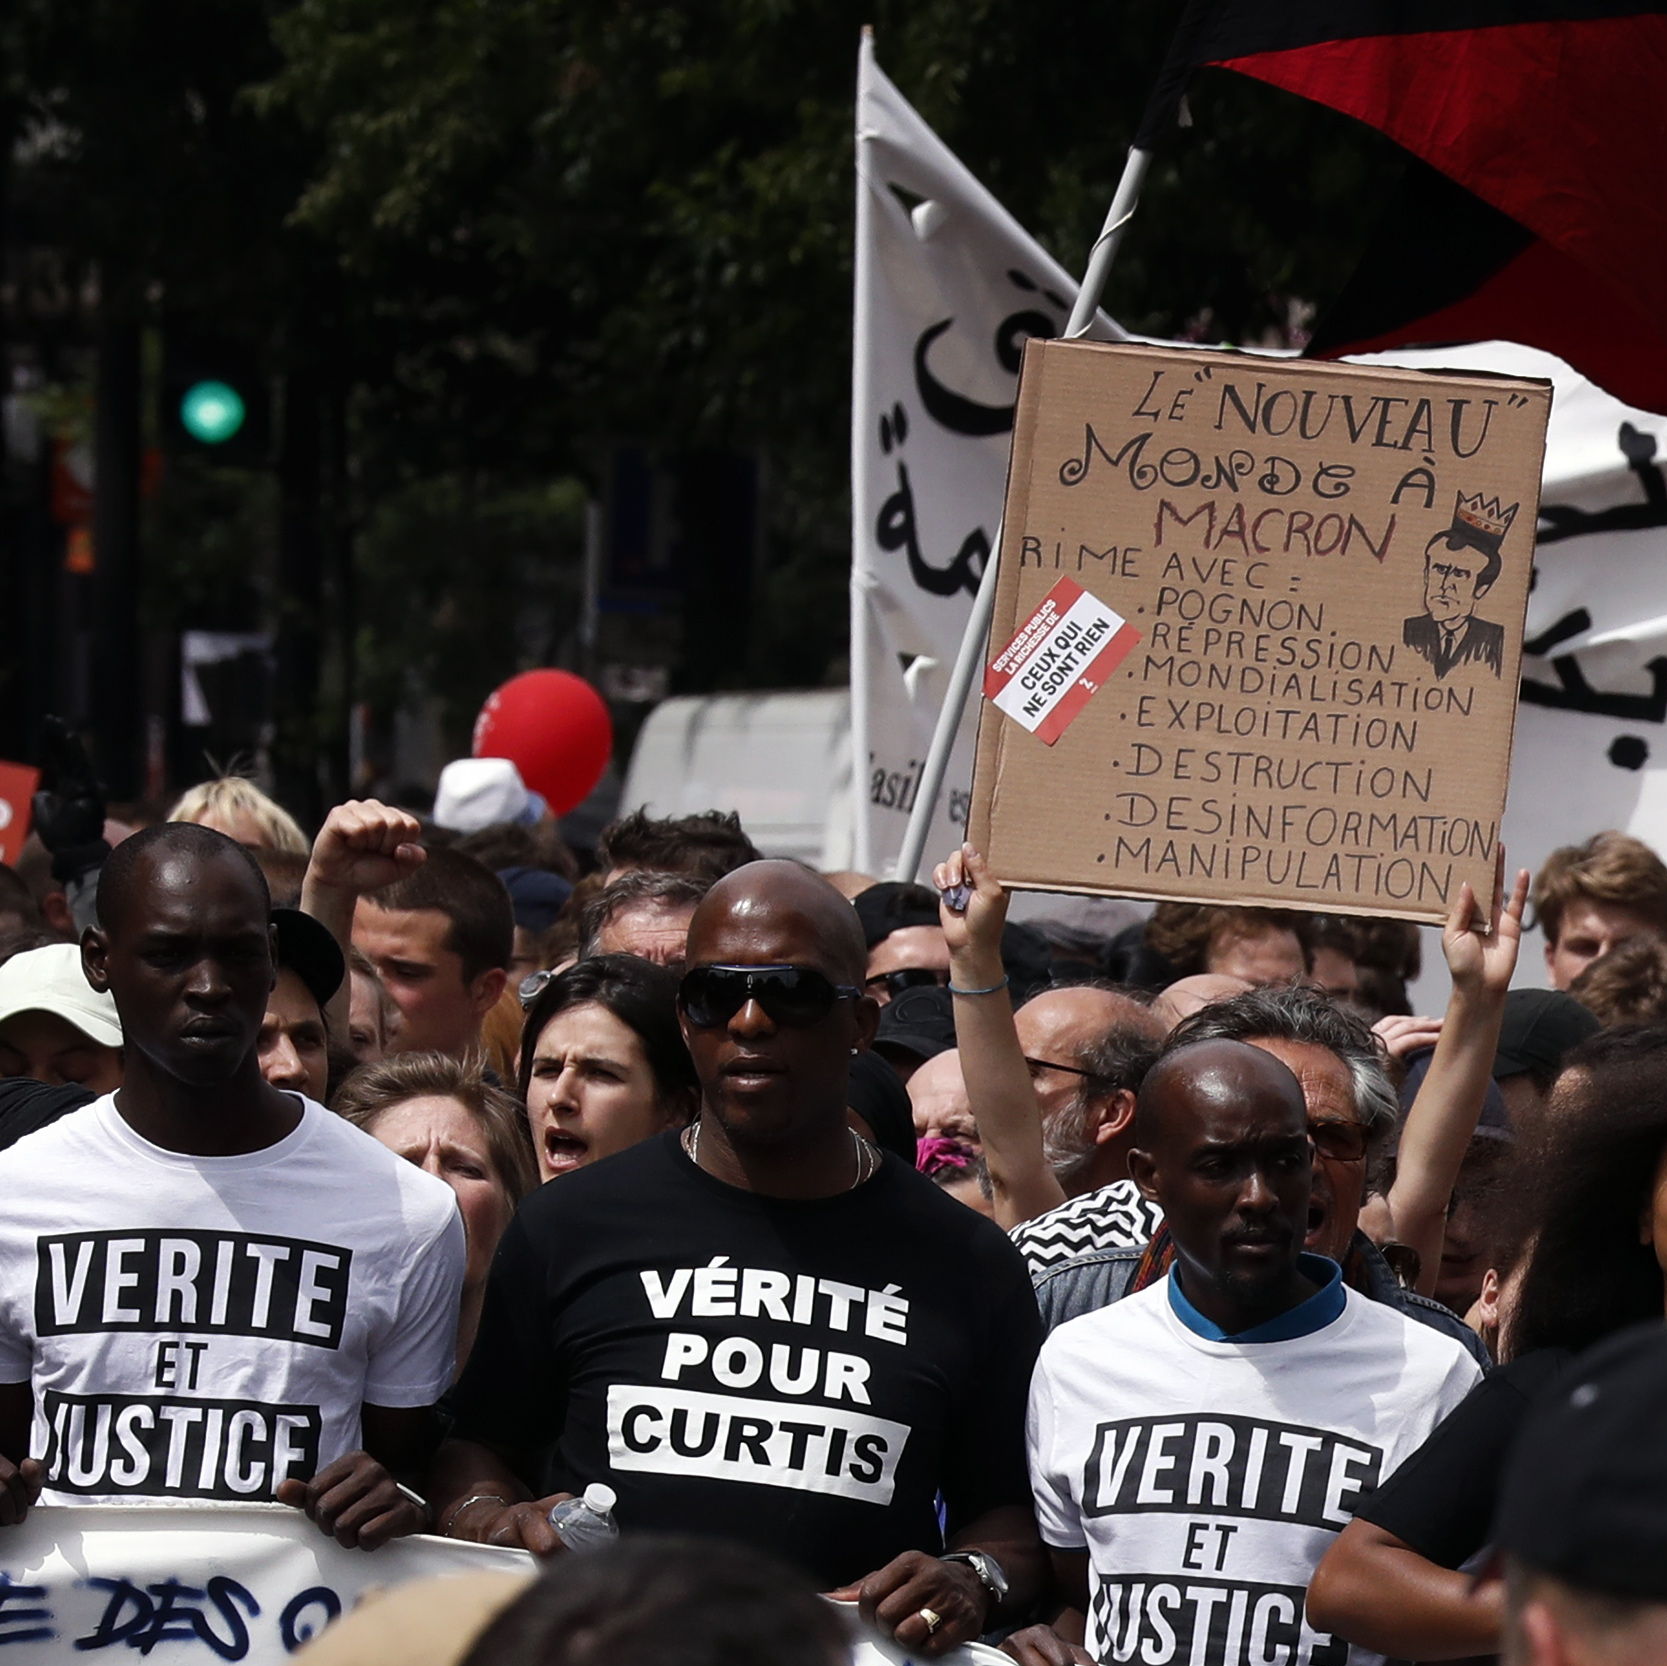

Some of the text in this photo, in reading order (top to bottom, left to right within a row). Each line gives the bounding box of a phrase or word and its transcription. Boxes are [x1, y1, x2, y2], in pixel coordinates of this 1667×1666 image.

[1059, 423, 1356, 498] MONDE
[1153, 500, 1398, 563] MACRON
[1157, 587, 1326, 631] POGNON
[1162, 555, 1270, 589] AVEC
[991, 597, 1057, 673] SERVICES PUBLICS
[1003, 610, 1060, 675] LA RICHESSE DE
[1017, 619, 1084, 692] CEUX QUI
[1021, 616, 1110, 718] NE SONT RIEN
[46, 1236, 344, 1339] VERITE
[640, 1254, 910, 1346] VÉRITÉ
[154, 1341, 209, 1390] ET
[661, 1333, 873, 1406] POUR
[43, 1399, 318, 1493] JUSTICE
[621, 1401, 889, 1485] CURTIS
[1095, 1422, 1382, 1524] VERITE
[1182, 1523, 1238, 1572] ET
[73, 1575, 261, 1663] DES
